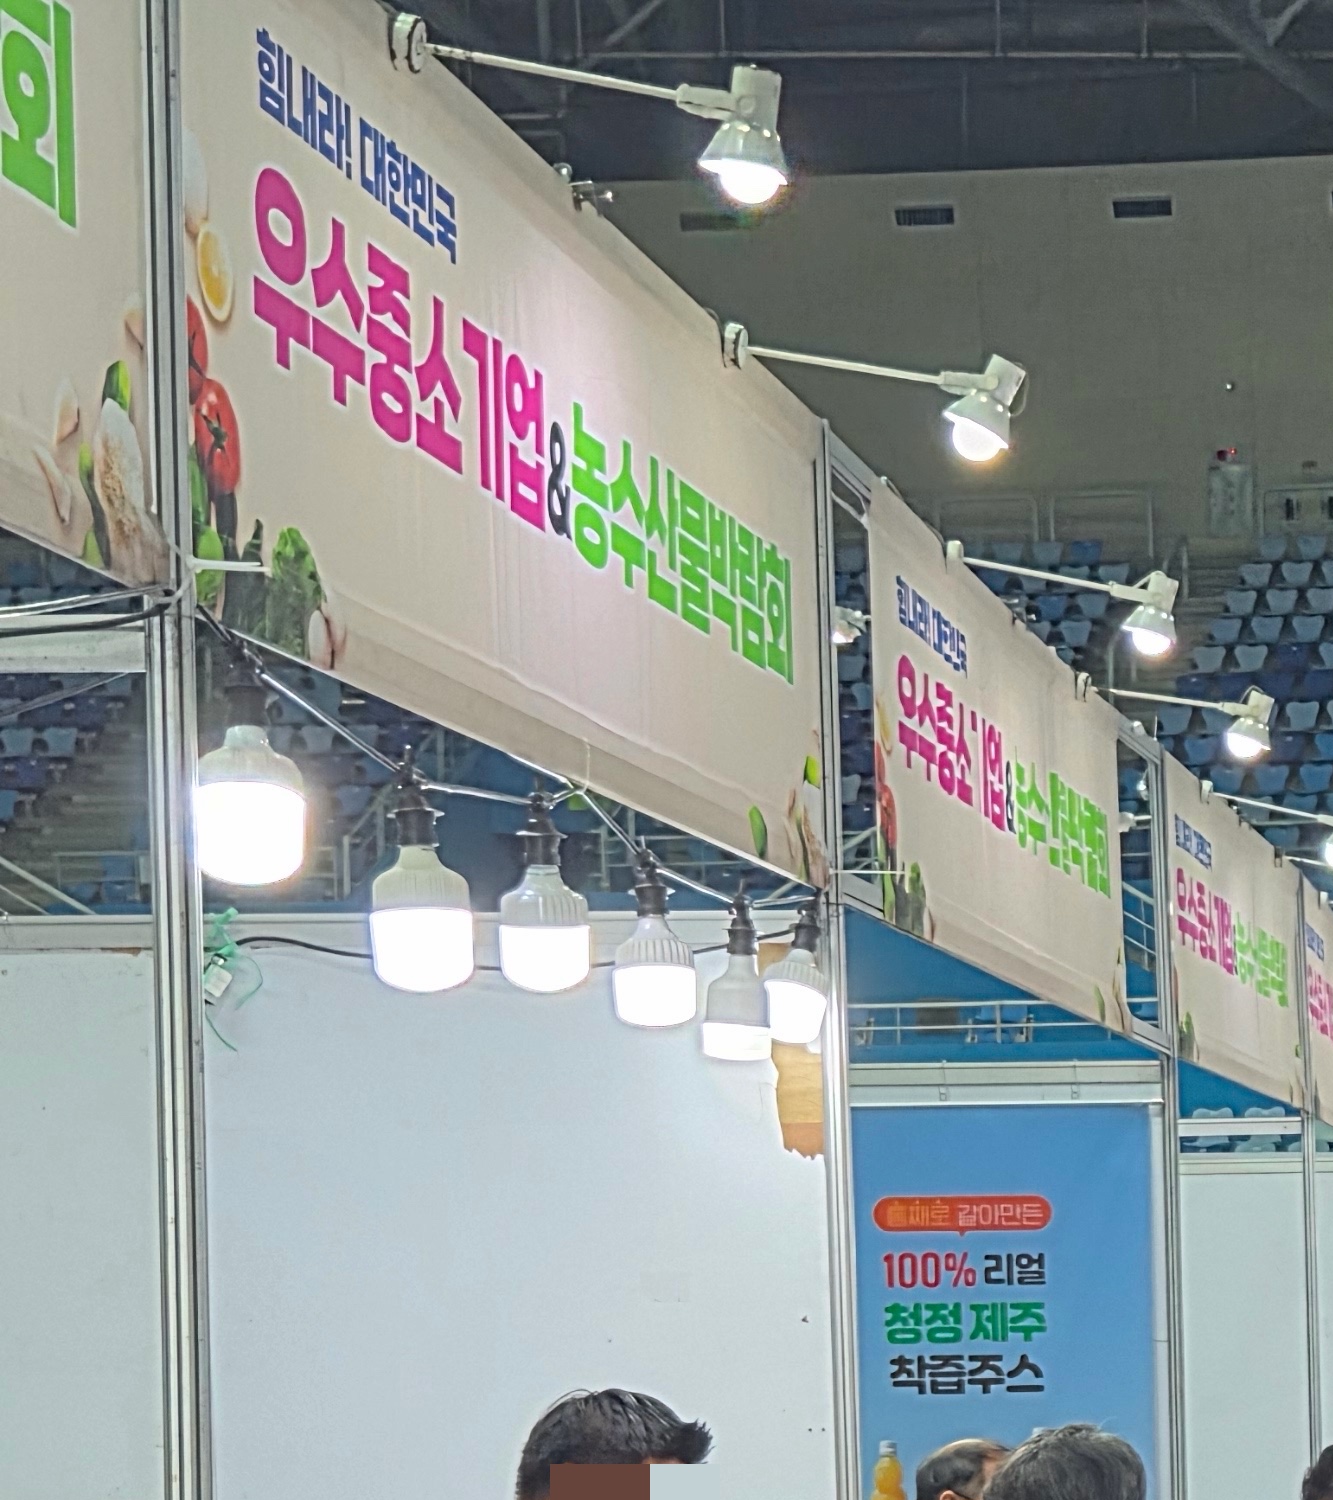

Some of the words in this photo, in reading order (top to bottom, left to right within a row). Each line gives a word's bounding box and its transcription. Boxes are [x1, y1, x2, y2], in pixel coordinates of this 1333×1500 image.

[256, 27, 353, 180] 힘내라!
[359, 116, 457, 266] 대한민국
[957, 1203, 1044, 1227] 갈아만든
[883, 1252, 977, 1288] 100%
[984, 1252, 1047, 1286] 리얼
[884, 1302, 962, 1345] 청정
[970, 1302, 1047, 1343] 제주
[890, 1354, 1045, 1395] 착즙주스
